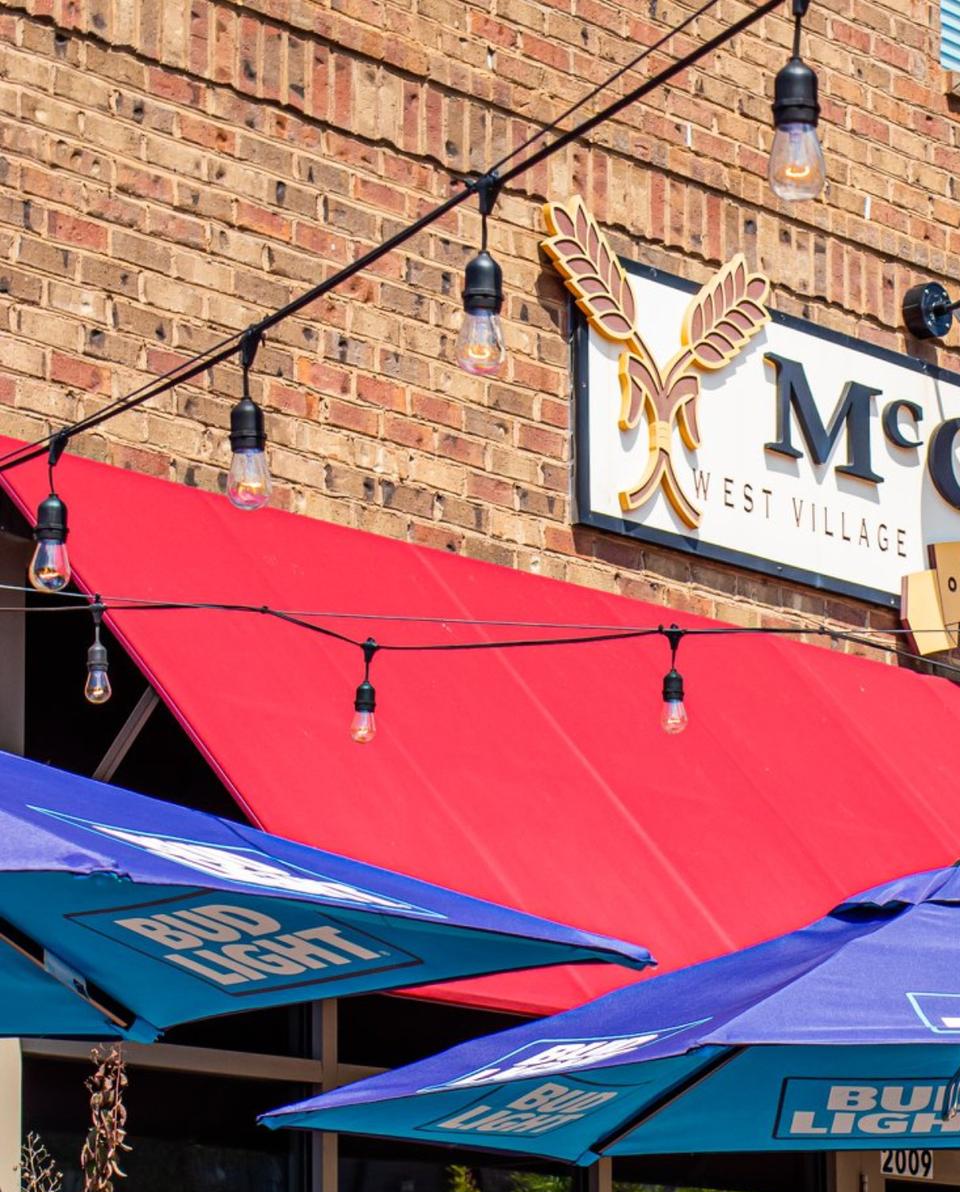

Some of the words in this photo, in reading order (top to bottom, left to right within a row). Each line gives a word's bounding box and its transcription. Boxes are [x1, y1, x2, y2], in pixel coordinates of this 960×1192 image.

[692, 467, 772, 519] WEST
[792, 497, 907, 557] VILLAGE
[113, 904, 282, 950] BUD
[163, 925, 384, 985] LIGHT
[506, 1081, 618, 1114] BUD
[437, 1105, 585, 1133] LIGHT
[881, 1150, 932, 1177] 2009
